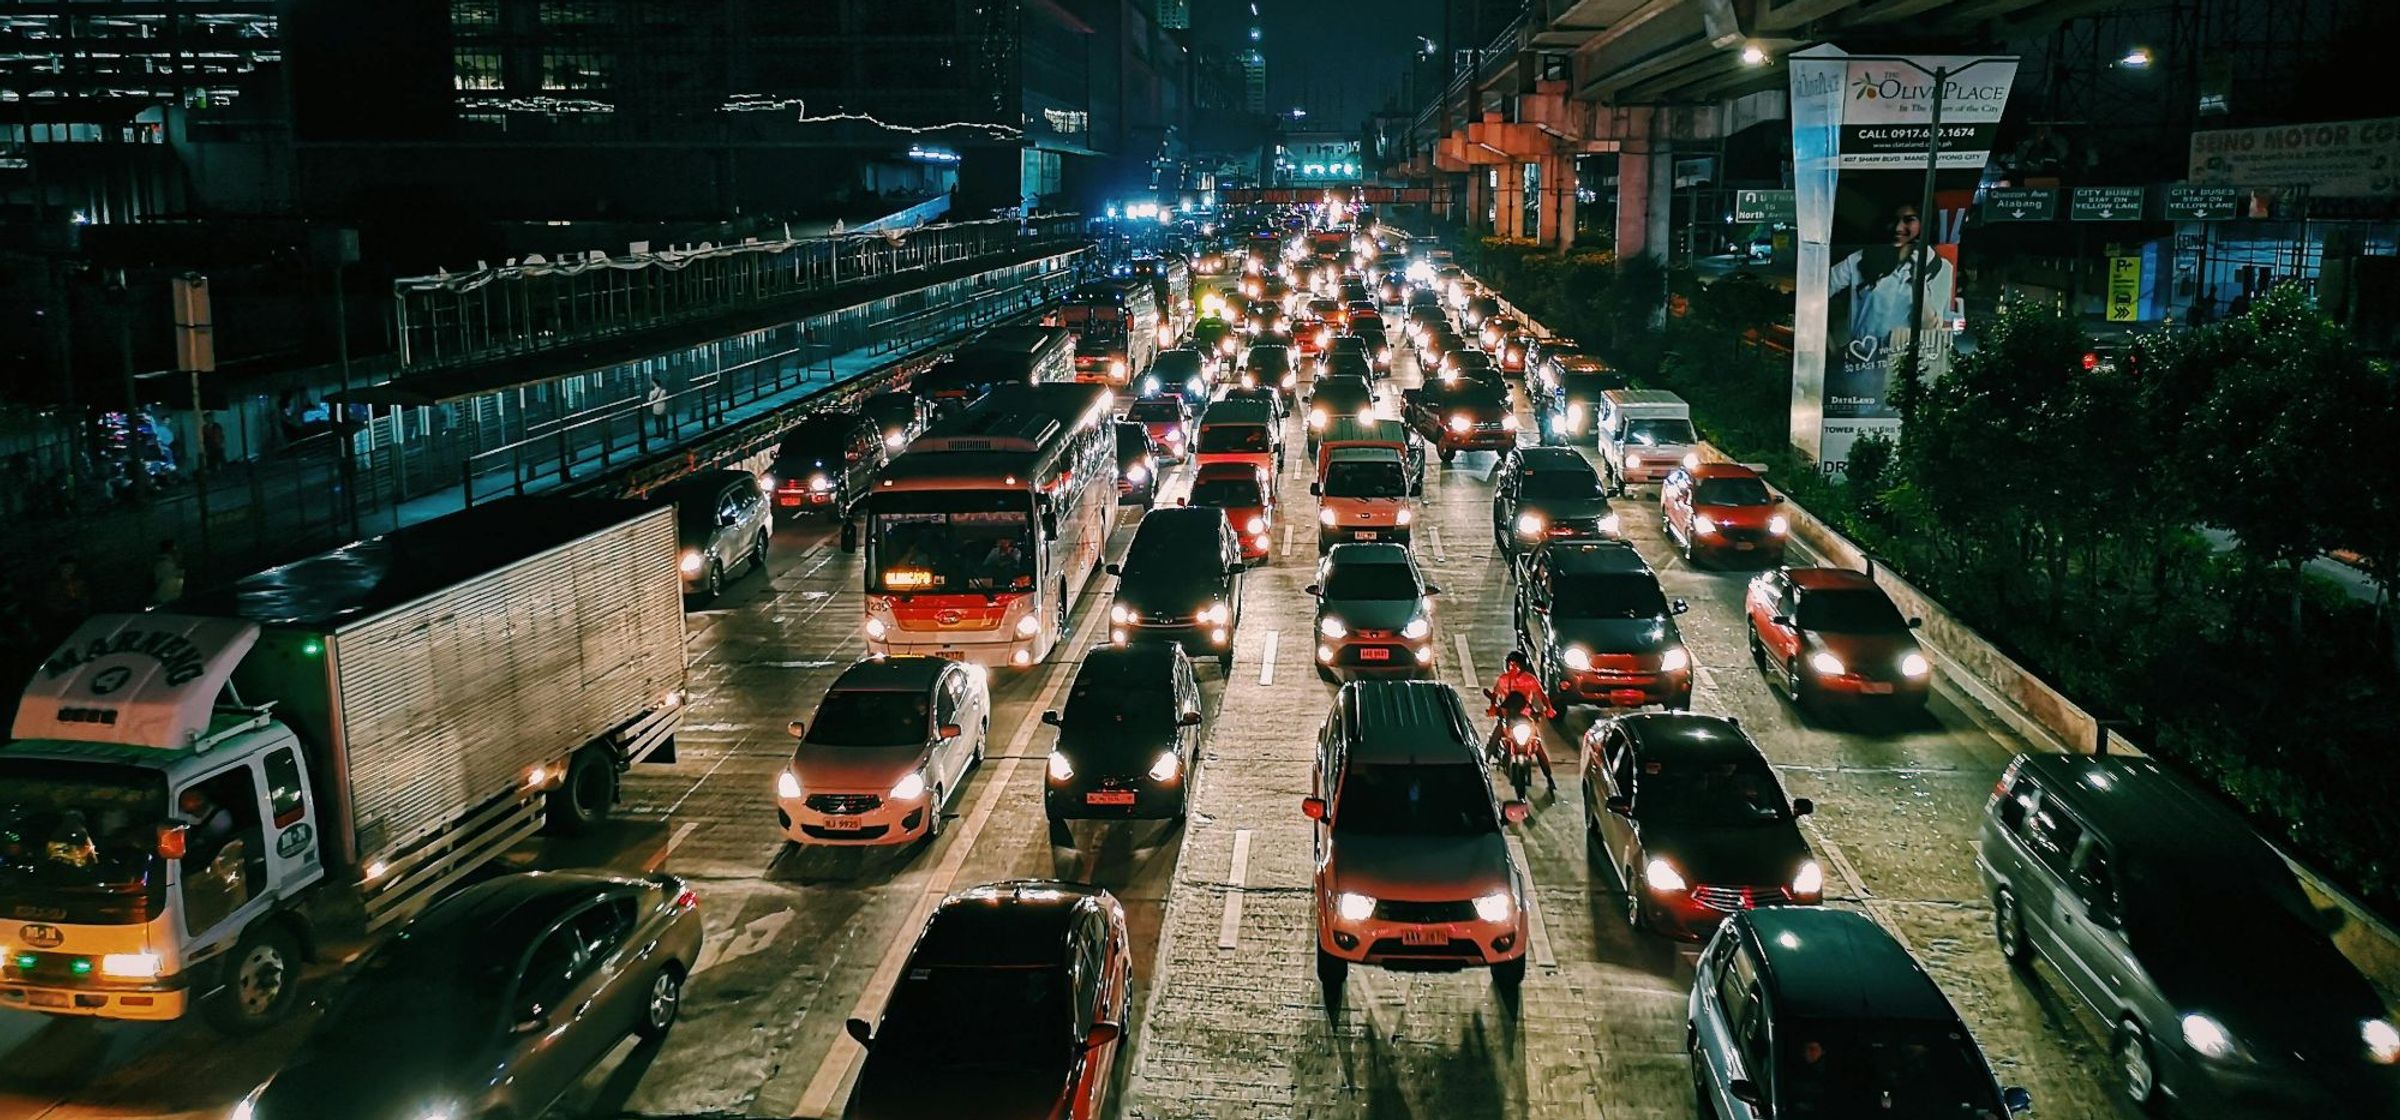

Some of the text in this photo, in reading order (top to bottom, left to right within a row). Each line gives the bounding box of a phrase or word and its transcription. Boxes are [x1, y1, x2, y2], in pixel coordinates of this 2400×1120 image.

[1879, 79, 2005, 101] OLIV PLACE
[1858, 129, 1888, 140] CALL
[2264, 126, 2349, 148] MOTOR
[2076, 189, 2140, 197] CITY BUSES
[2172, 188, 2194, 196] CITY
[1996, 199, 2043, 210] Alabang
[1738, 211, 1765, 220] North
[1824, 426, 1855, 435] TOWER
